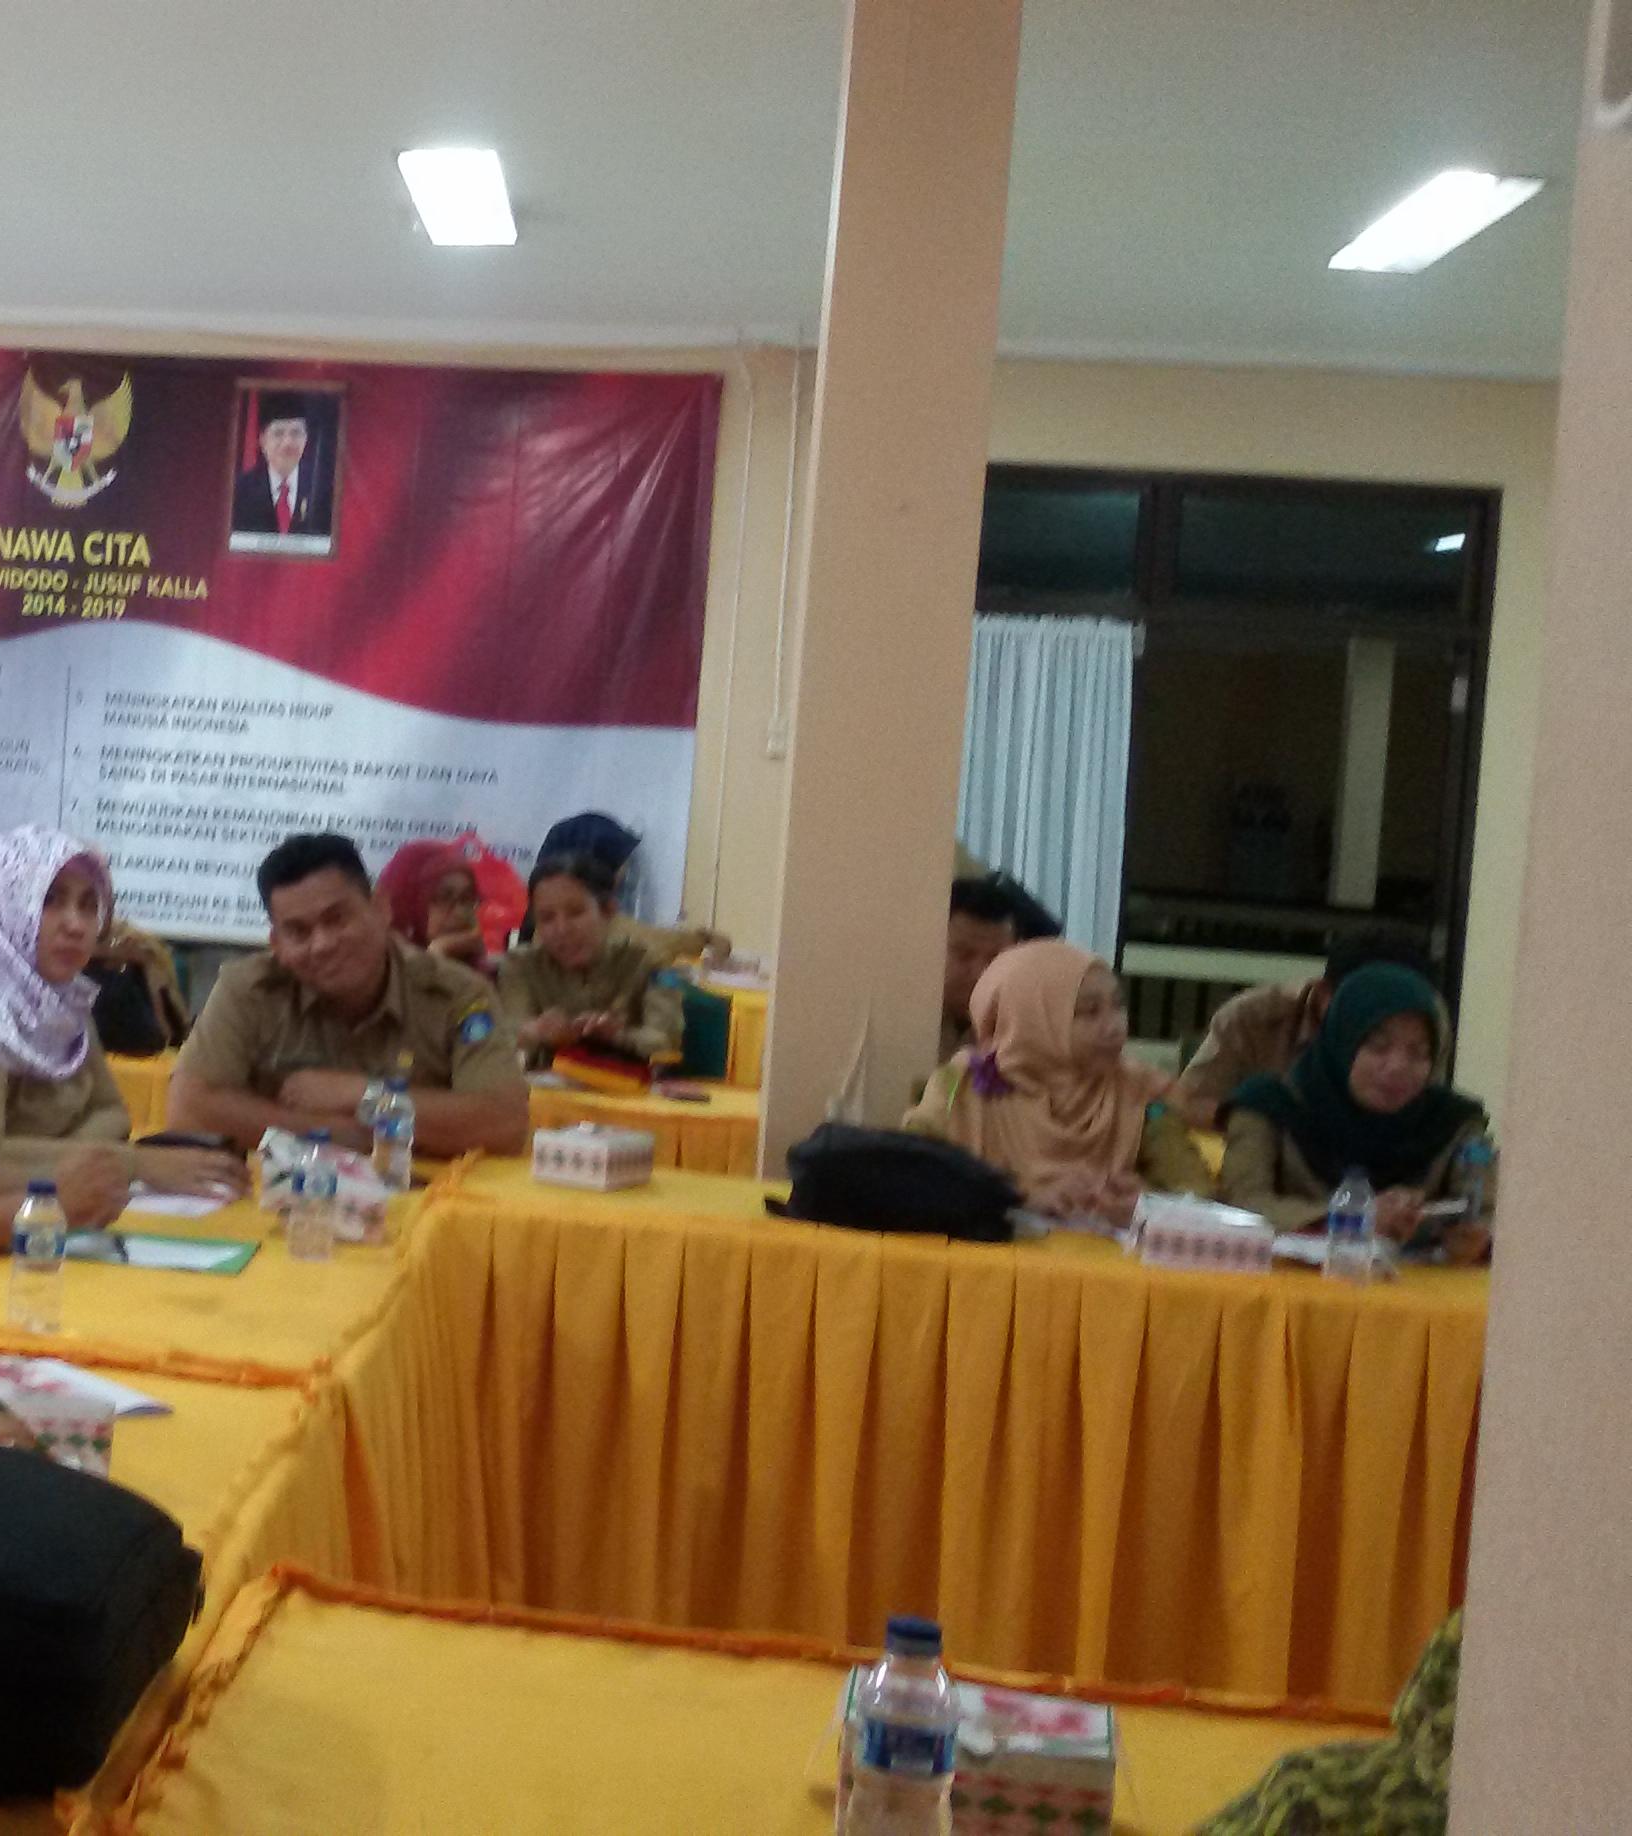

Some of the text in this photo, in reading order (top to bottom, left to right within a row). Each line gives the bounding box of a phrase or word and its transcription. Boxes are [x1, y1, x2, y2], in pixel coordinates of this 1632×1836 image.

[82, 530, 151, 568] CITA
[83, 572, 143, 597] JUSUF
[146, 576, 208, 600] KALLA
[21, 593, 67, 617] 2014
[81, 597, 127, 620] 2019
[105, 692, 217, 712] MENINGKATKAN
[221, 698, 286, 716] KUALITAS
[289, 701, 333, 719] HIDUP
[104, 711, 249, 735] MANUSIA INDONESIA
[100, 764, 344, 793] SAING DI PASAR INTERNASIONAL
[102, 745, 226, 767] MENINGKATKAN
[230, 752, 349, 775] PRODUKTIVITAS
[353, 760, 410, 779] RAKYAT
[417, 763, 453, 782] DAN
[457, 766, 498, 785] DAYA
[96, 799, 208, 820] MEWUJUDKAN
[213, 806, 321, 827] KEMANDIRIAN
[325, 812, 404, 832] EKONOMI
[407, 817, 478, 836] DENGAN
[107, 853, 256, 879] ELAKUKAN REVOLU
